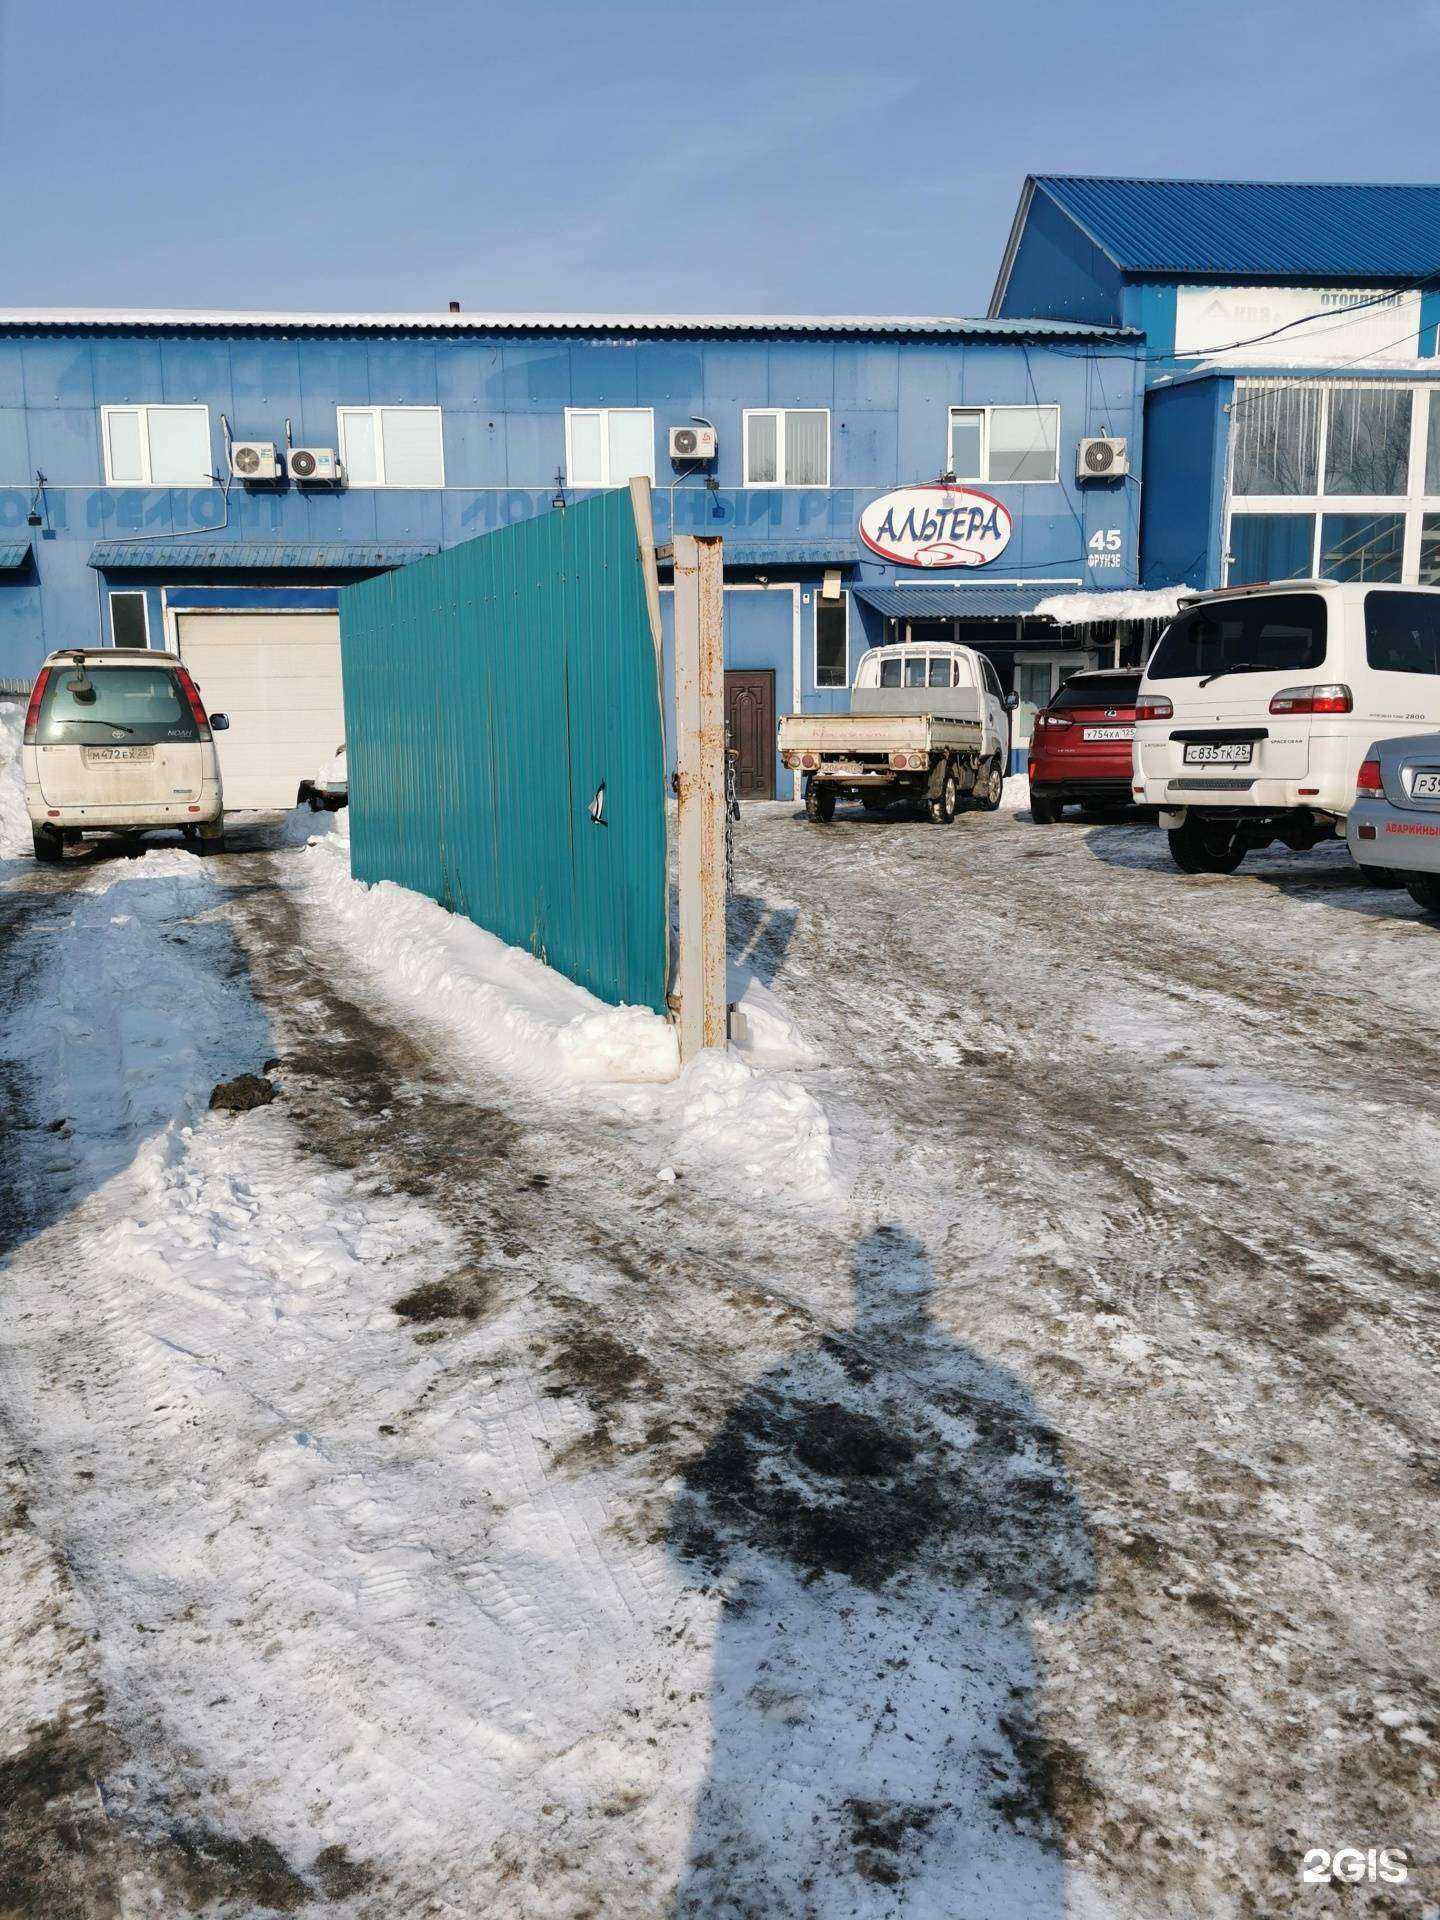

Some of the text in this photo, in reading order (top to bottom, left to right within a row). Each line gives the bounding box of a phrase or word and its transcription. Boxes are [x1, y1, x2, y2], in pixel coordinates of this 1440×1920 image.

[876, 506, 1002, 543] АЛЬТЕРА
[1088, 529, 1121, 550] 45
[1087, 553, 1121, 568] ФРУНЗЕ
[1385, 823, 1440, 836] АВАРИЙНЫ
